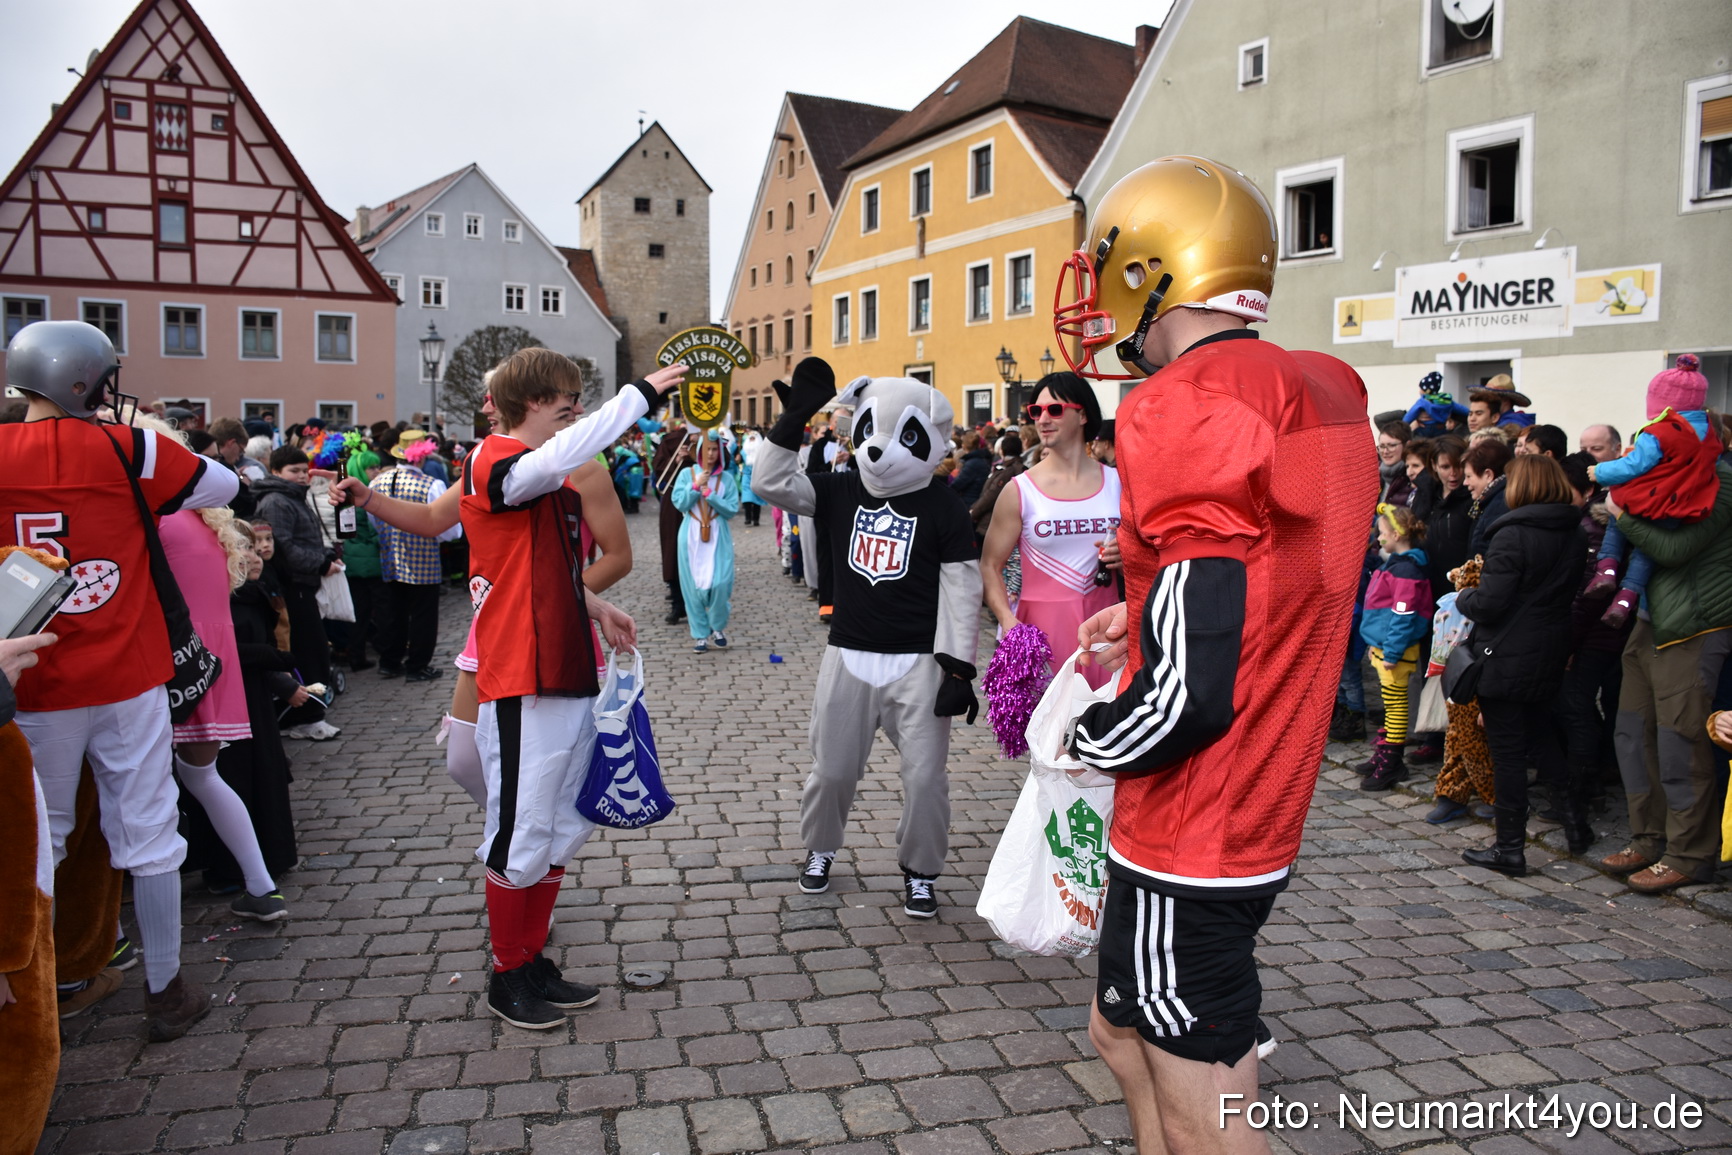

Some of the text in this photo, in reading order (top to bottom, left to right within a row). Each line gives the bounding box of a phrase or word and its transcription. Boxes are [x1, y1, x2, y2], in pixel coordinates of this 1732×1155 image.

[1411, 277, 1554, 315] MAYINGER
[1431, 313, 1529, 330] BESTATTUNGEN
[659, 332, 747, 365] Blaskapelle
[678, 350, 732, 374] Pilsach
[695, 368, 716, 378] 1954
[15, 511, 69, 577] 5
[855, 533, 901, 573] NFL
